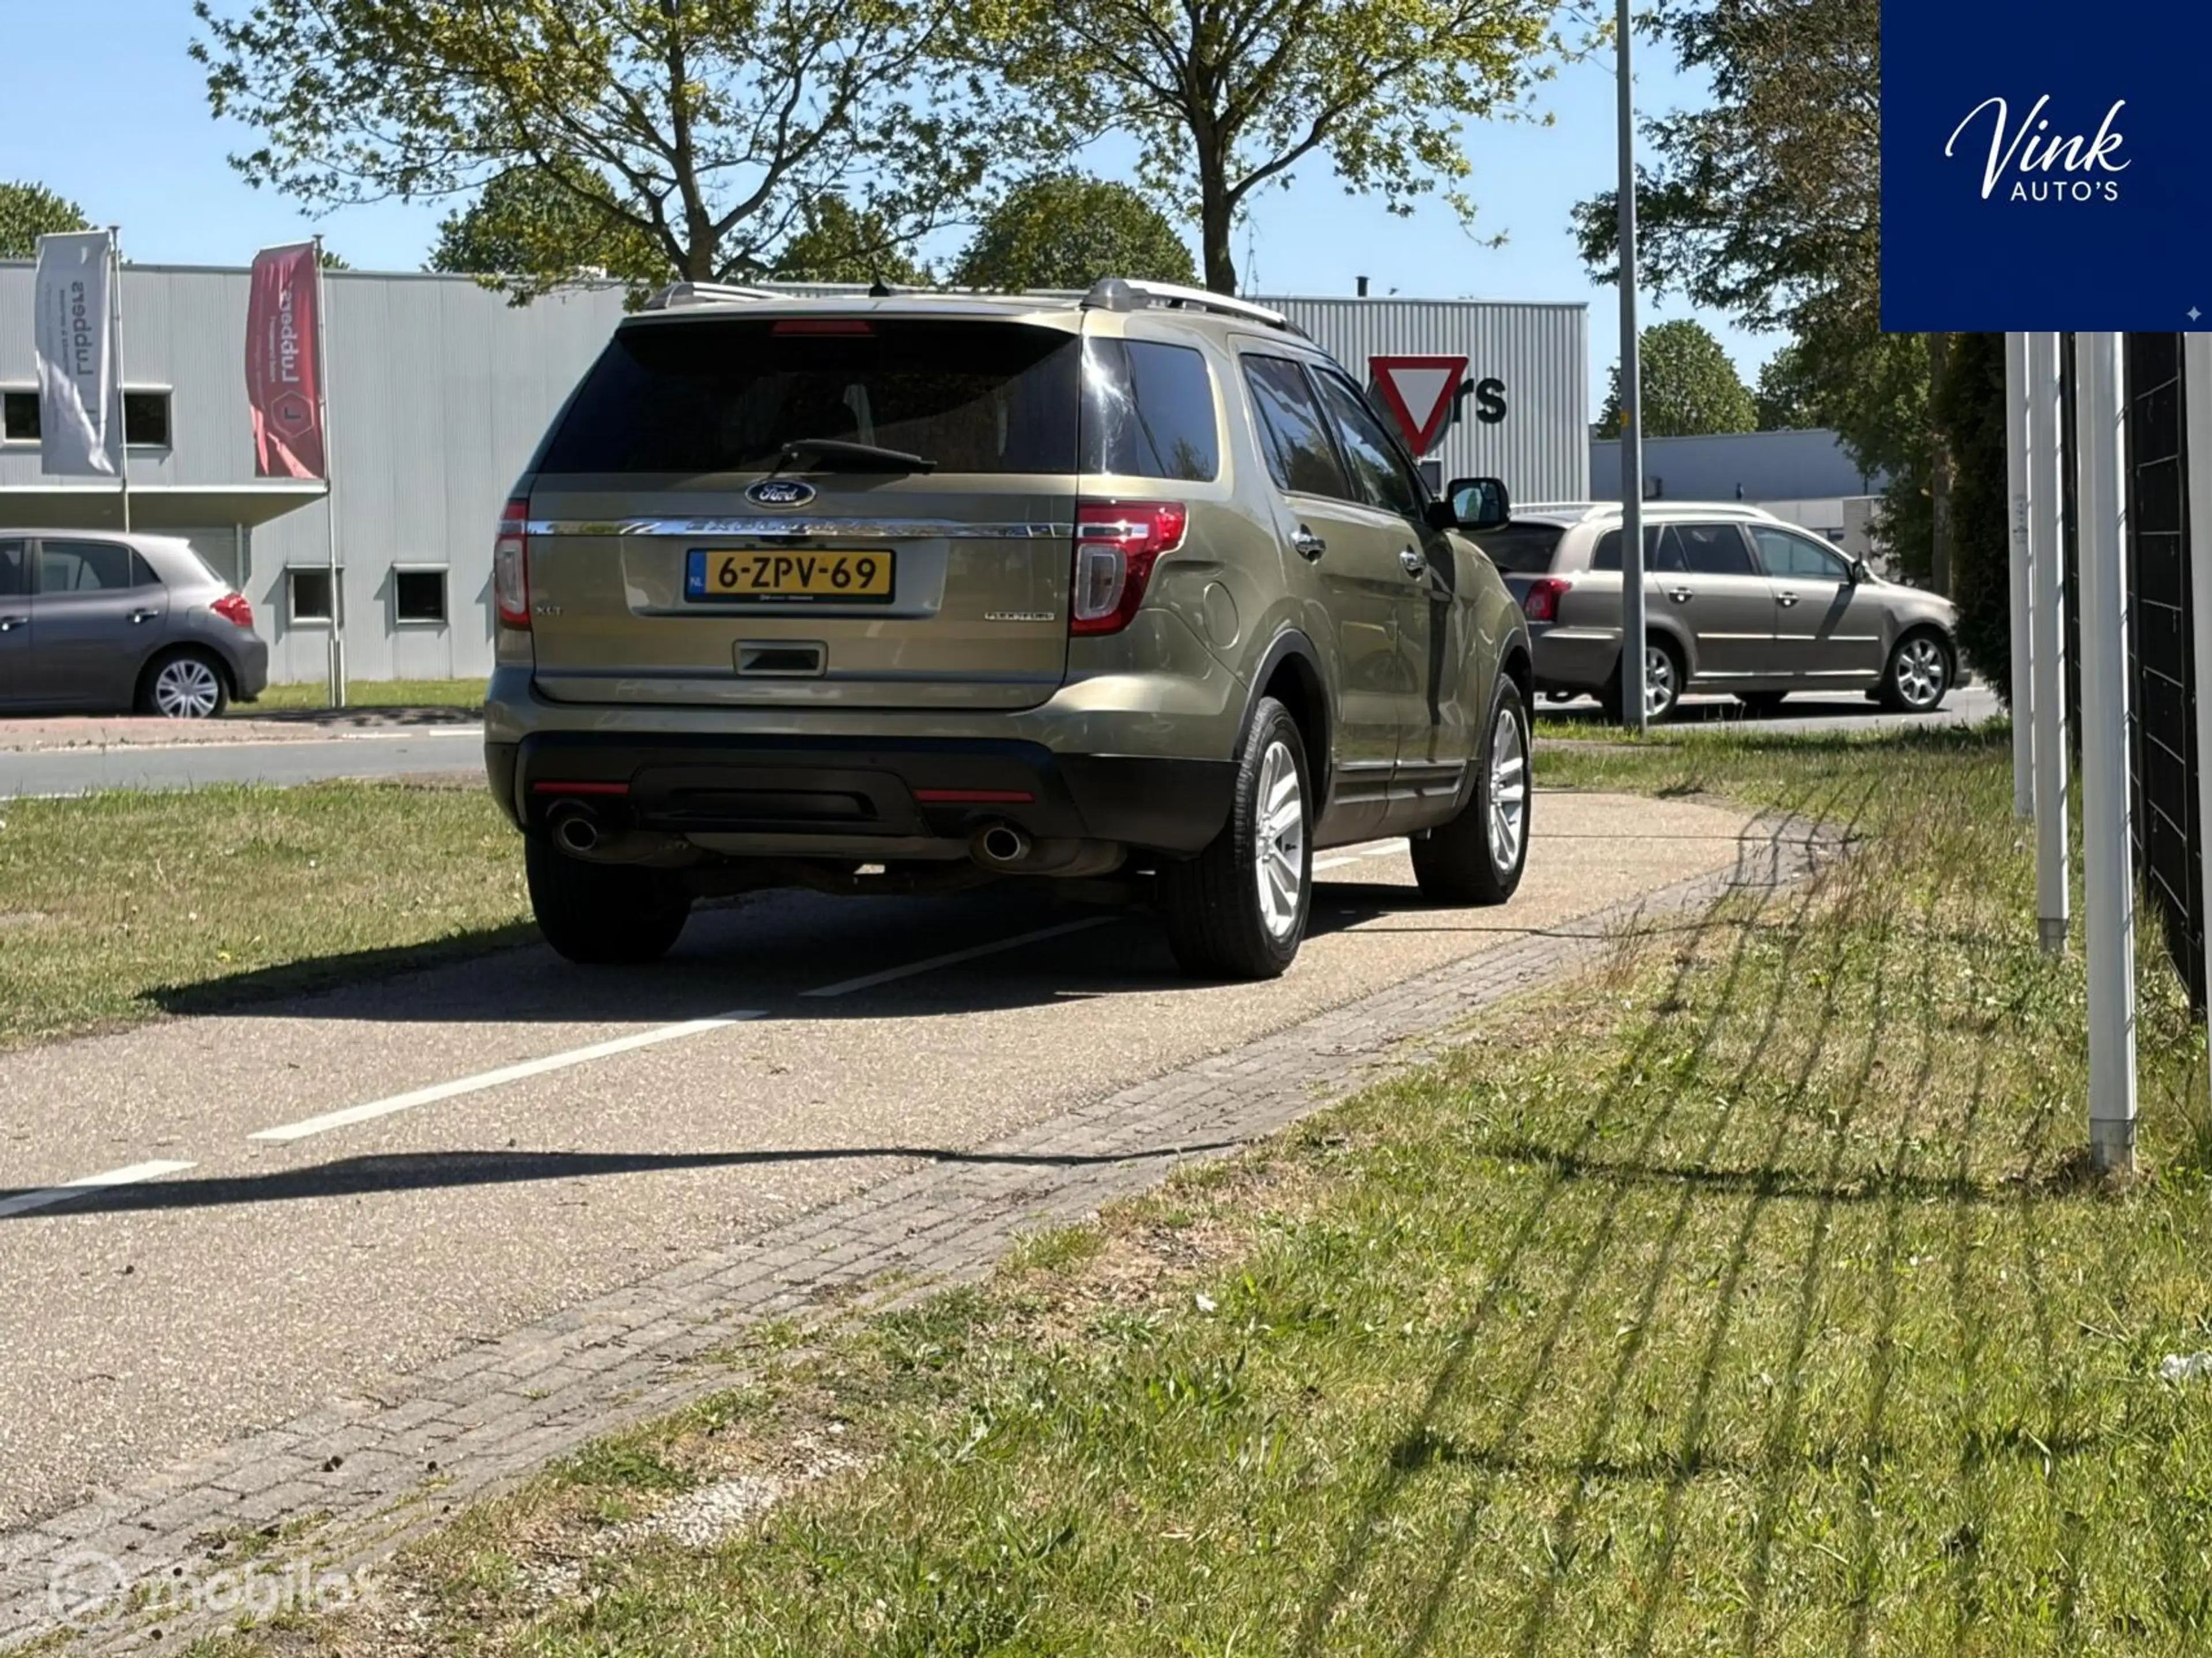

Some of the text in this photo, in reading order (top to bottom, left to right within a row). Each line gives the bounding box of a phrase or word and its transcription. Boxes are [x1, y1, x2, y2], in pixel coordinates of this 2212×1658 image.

[1452, 377, 1507, 424] rs
[759, 484, 798, 501] Ford
[690, 576, 704, 587] NL
[718, 556, 877, 589] 6-ZPV-69
